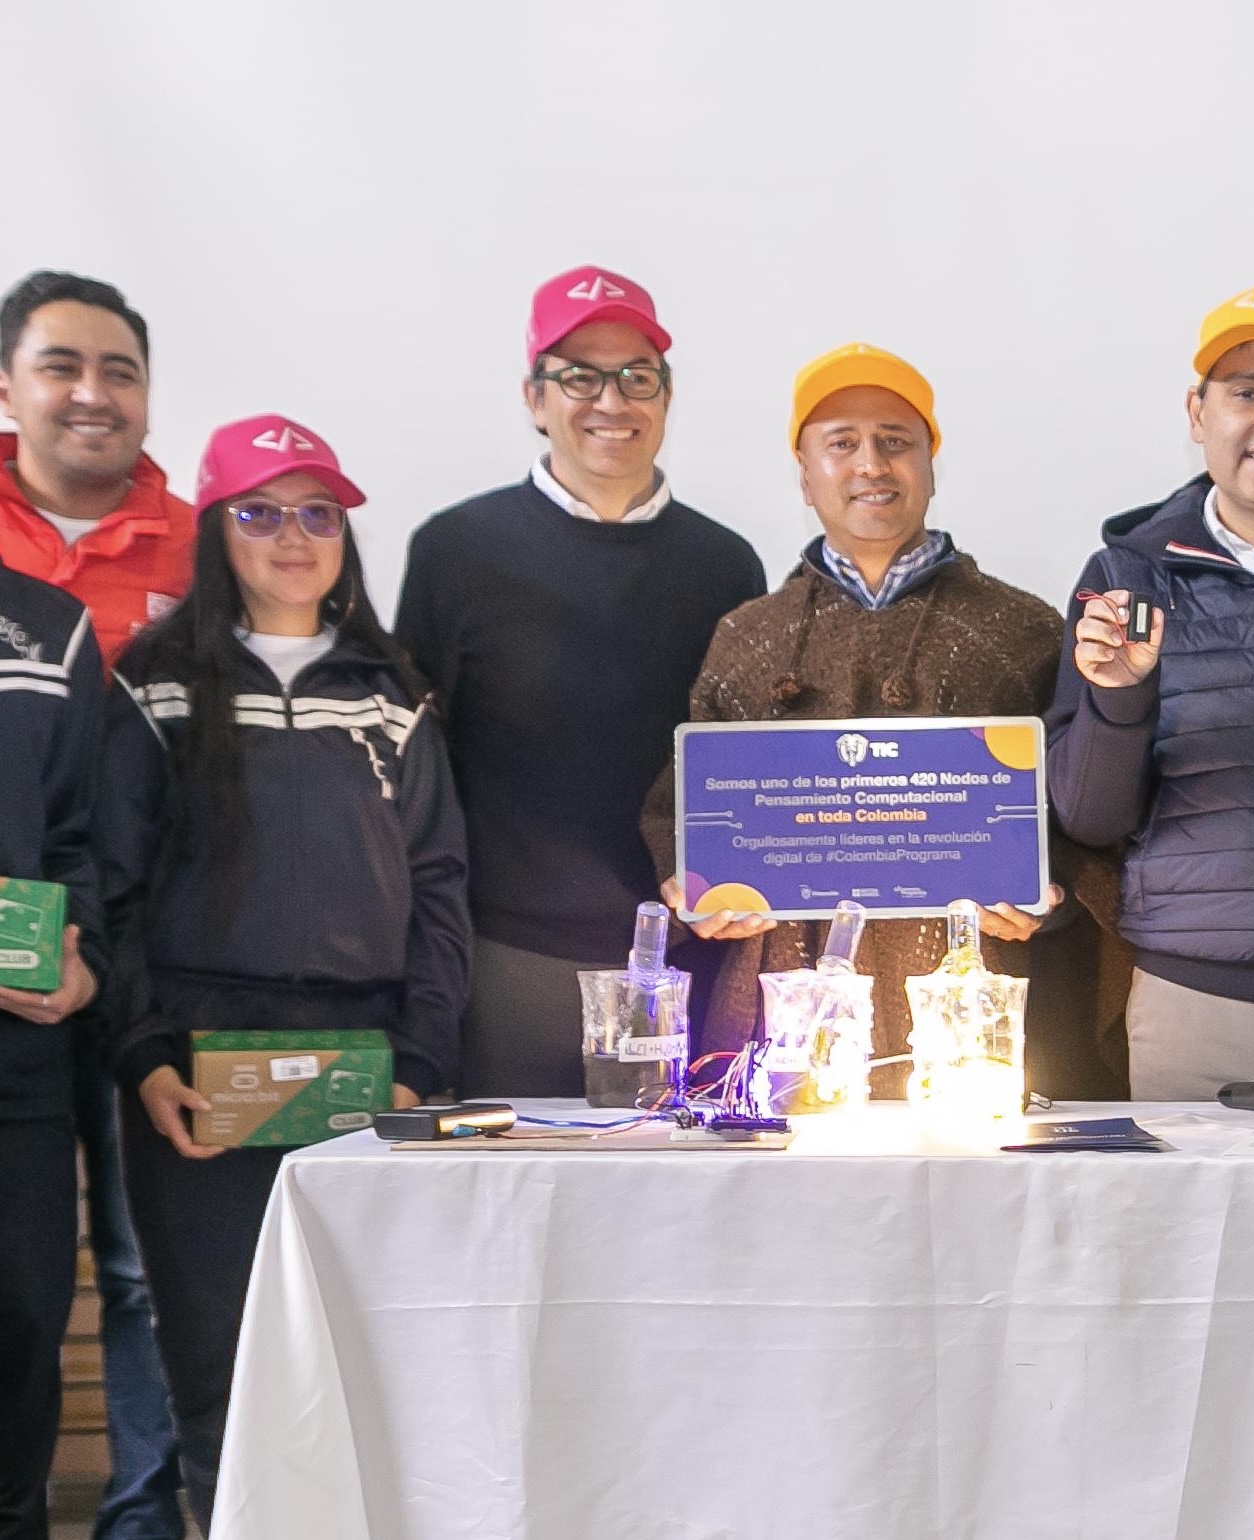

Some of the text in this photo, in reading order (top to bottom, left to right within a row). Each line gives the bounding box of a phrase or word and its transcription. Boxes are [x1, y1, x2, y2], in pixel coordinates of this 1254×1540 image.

[869, 742, 899, 758] TIC
[705, 772, 1011, 790] Somos uno de los primeros 420 Nodos de
[755, 790, 967, 807] Pensamiento Computacional
[796, 808, 927, 823] en toda Colombia
[732, 835, 837, 849] Orgullosamente
[888, 834, 905, 845] en
[908, 832, 921, 845] la
[763, 848, 961, 867] digital de #ColombiaPrograma
